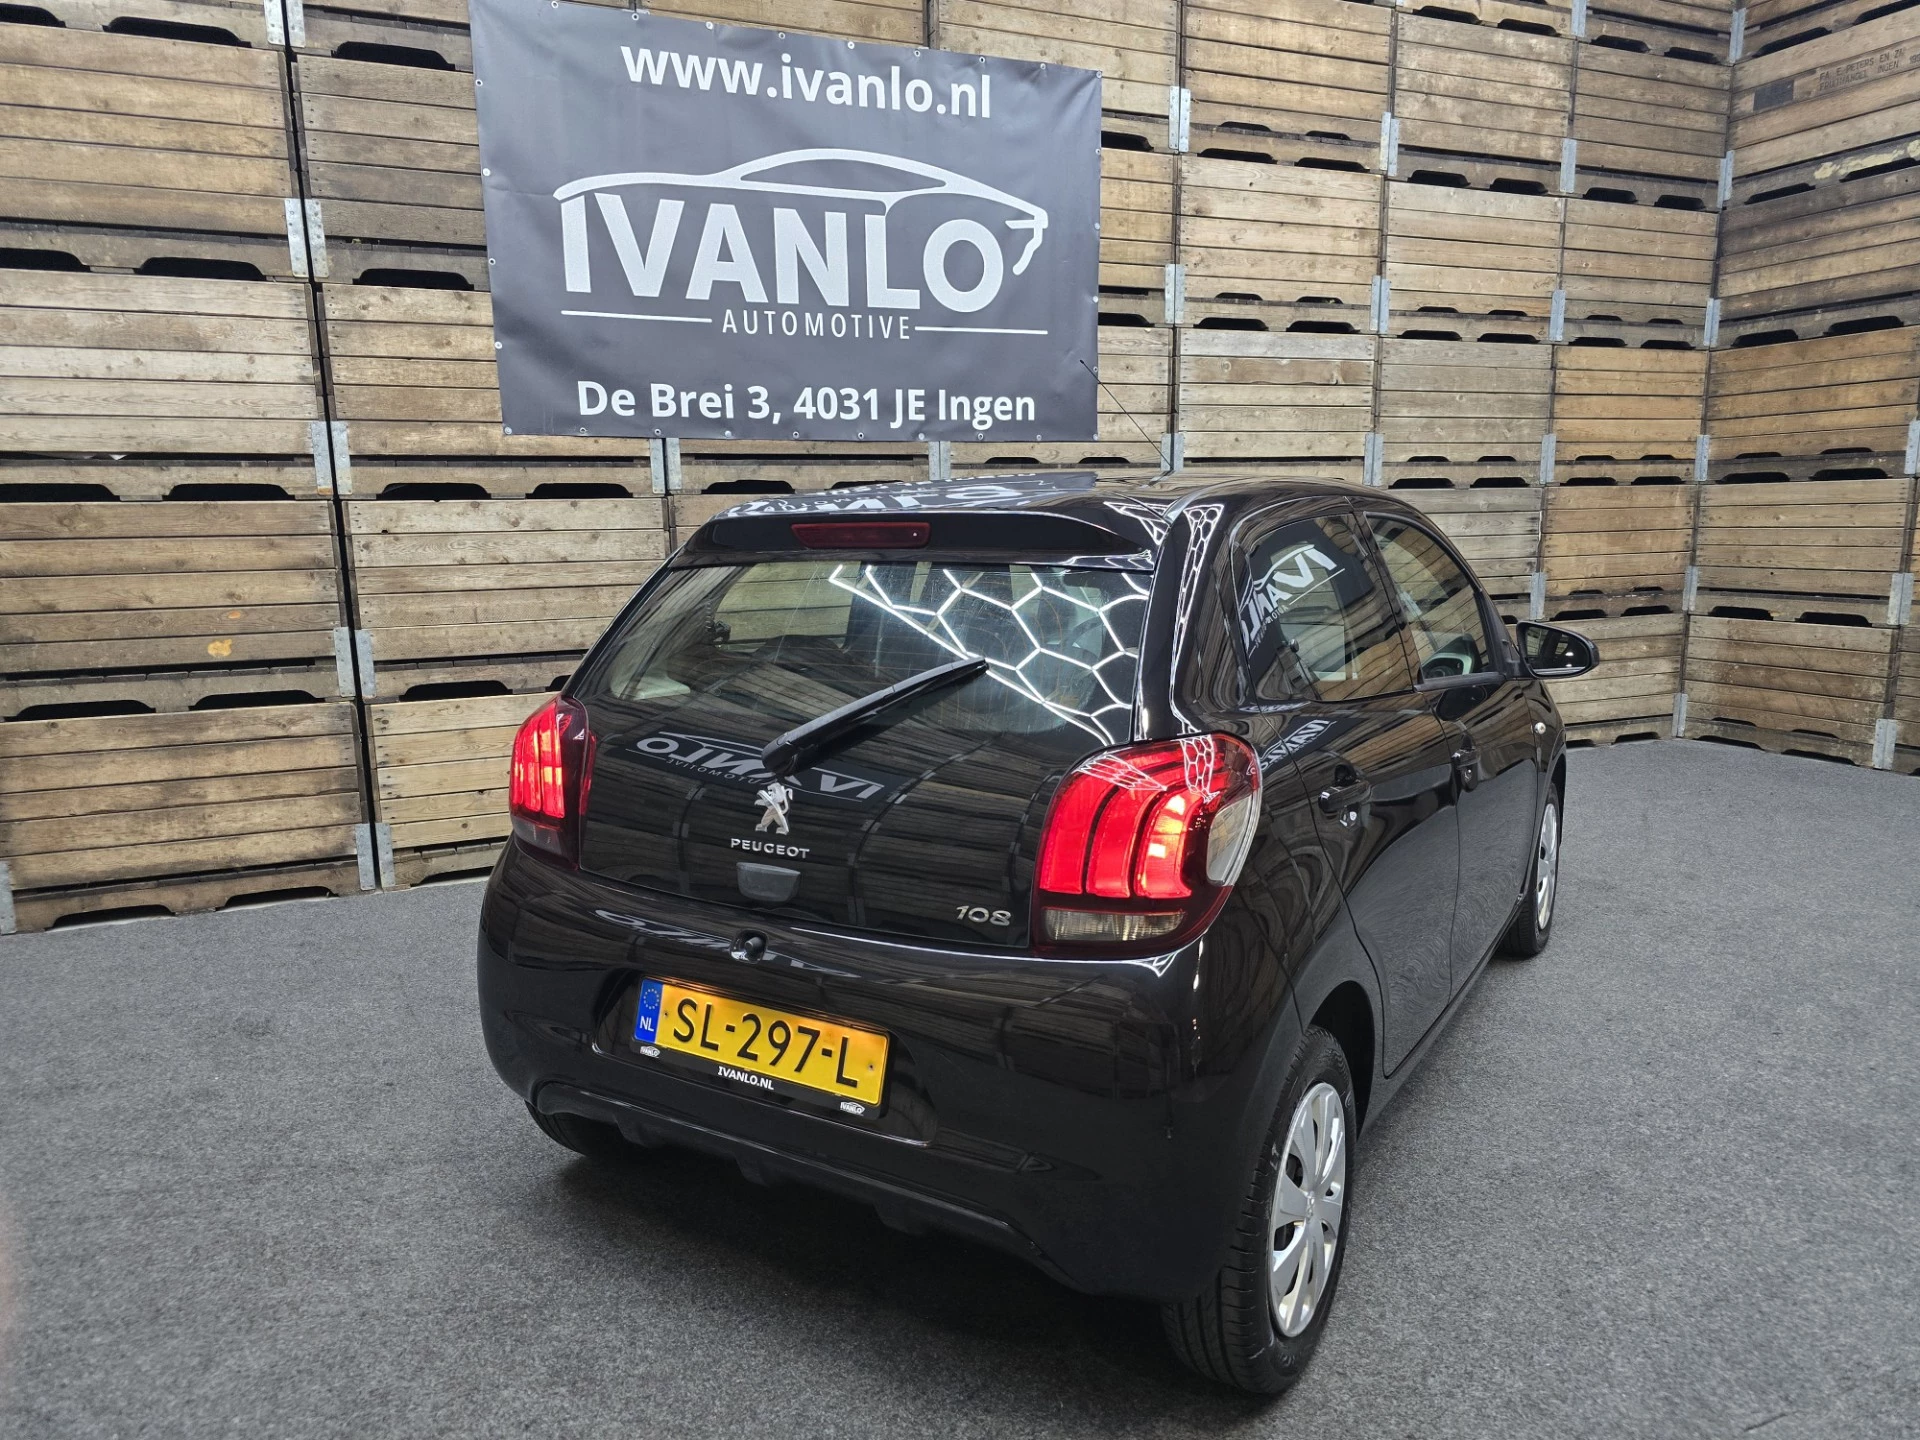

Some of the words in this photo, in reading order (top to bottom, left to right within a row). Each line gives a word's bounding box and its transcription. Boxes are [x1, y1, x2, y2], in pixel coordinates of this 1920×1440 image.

[1880, 51, 1890, 63] EN
[620, 45, 991, 119] www.ivanlo.nl
[561, 193, 1004, 313] IVANLO
[722, 309, 911, 340] AUTOMOTIVE
[577, 380, 635, 417] De
[650, 382, 734, 420] Brei
[747, 386, 781, 426] 3,
[793, 386, 879, 421] 4031
[890, 389, 926, 430] JE
[938, 389, 1036, 432] Ingen
[730, 838, 810, 859] PEUGEOT
[956, 905, 1011, 927] 108
[639, 1016, 655, 1033] NL
[673, 998, 859, 1089] SL-297-L
[717, 1066, 775, 1091] IVANLO.NL
[840, 1102, 865, 1115] IVANLO
